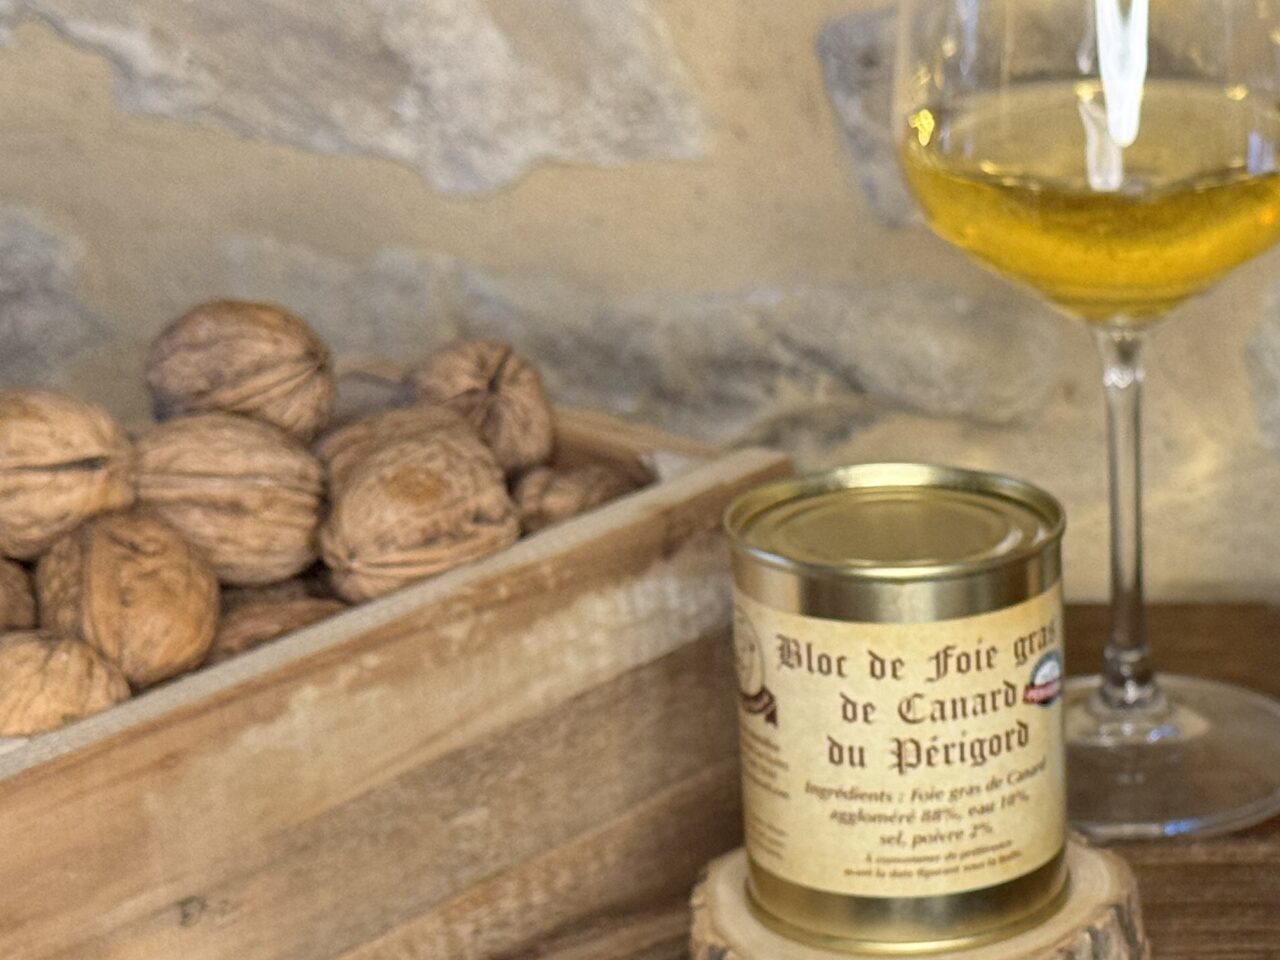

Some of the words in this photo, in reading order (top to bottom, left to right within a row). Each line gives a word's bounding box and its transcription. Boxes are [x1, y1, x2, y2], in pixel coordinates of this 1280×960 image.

[776, 633, 848, 678] Bloc
[867, 649, 905, 680] de
[925, 637, 997, 682] Foie
[839, 691, 877, 725] de
[898, 680, 1018, 725] Canard
[826, 735, 866, 769] du
[888, 719, 1030, 775] Périgord
